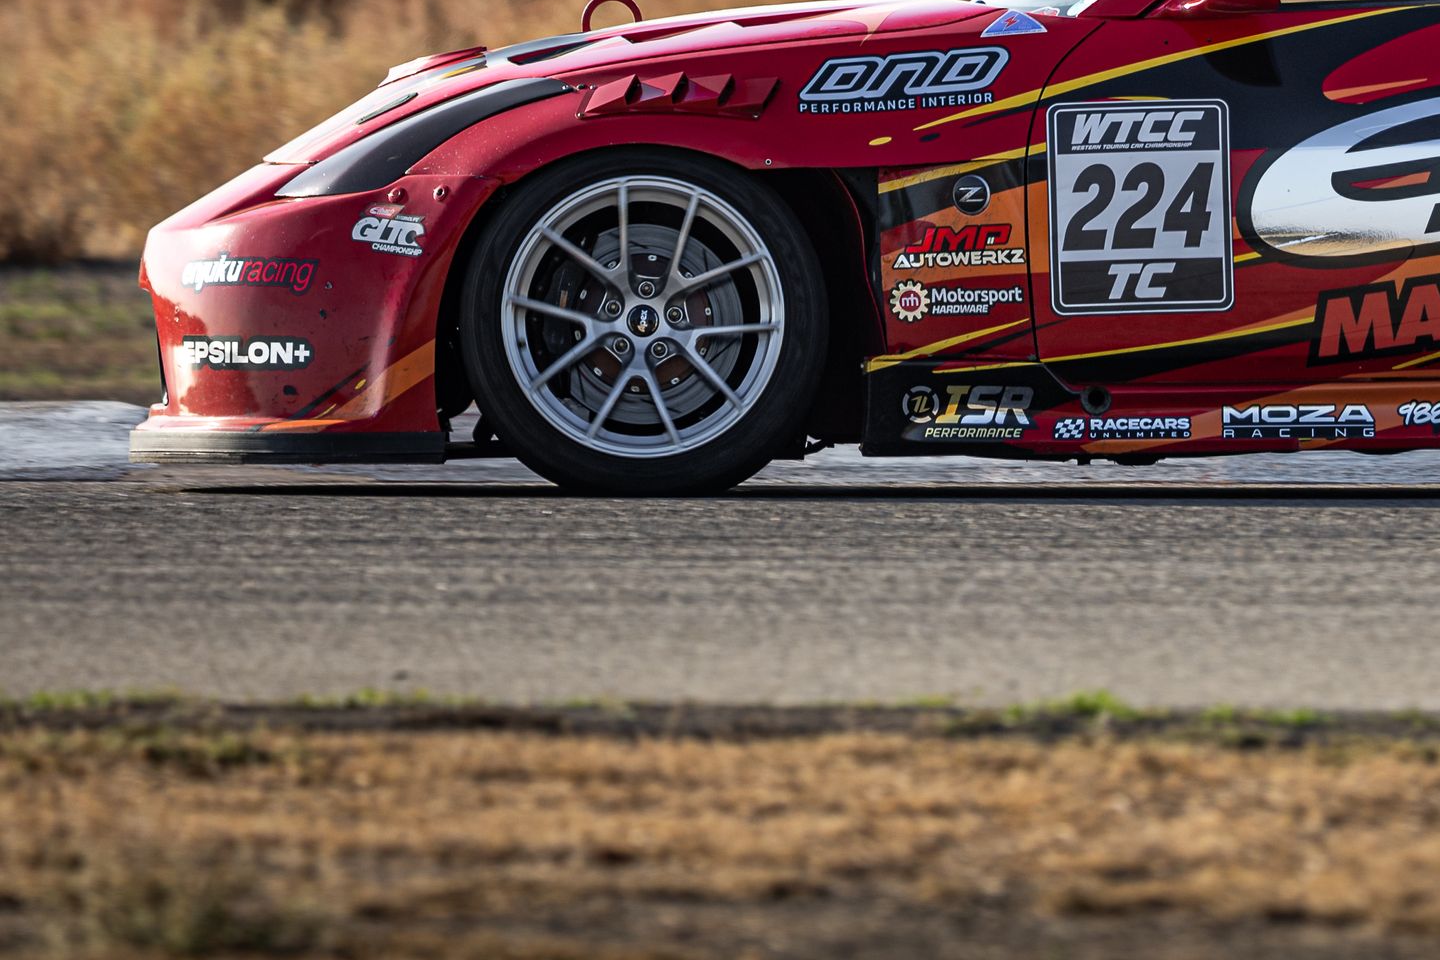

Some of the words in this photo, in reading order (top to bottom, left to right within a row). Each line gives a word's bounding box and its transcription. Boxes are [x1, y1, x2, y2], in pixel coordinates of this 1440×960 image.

[800, 98, 916, 114] PERFORMANCE
[922, 92, 993, 108] INTERIOR
[1071, 110, 1205, 145] WTCC
[1071, 144, 1101, 152] WESTERN
[1145, 141, 1192, 149] CHAMPIONSHIP
[1062, 161, 1215, 251] 224
[372, 242, 423, 256] CHAMPIONSHIP
[893, 249, 1025, 269] AUTOWERKZ
[1108, 262, 1177, 301] TC
[931, 287, 1023, 305] Motorsport
[932, 304, 989, 315] HARDWARE
[935, 385, 1034, 425] ISR
[1223, 405, 1375, 423] MOZA
[925, 427, 1023, 438] PERFORMANCE
[1090, 418, 1190, 430] RACECARS
[1223, 427, 1375, 438] RACING
[1089, 431, 1190, 439] UNLIMITED
